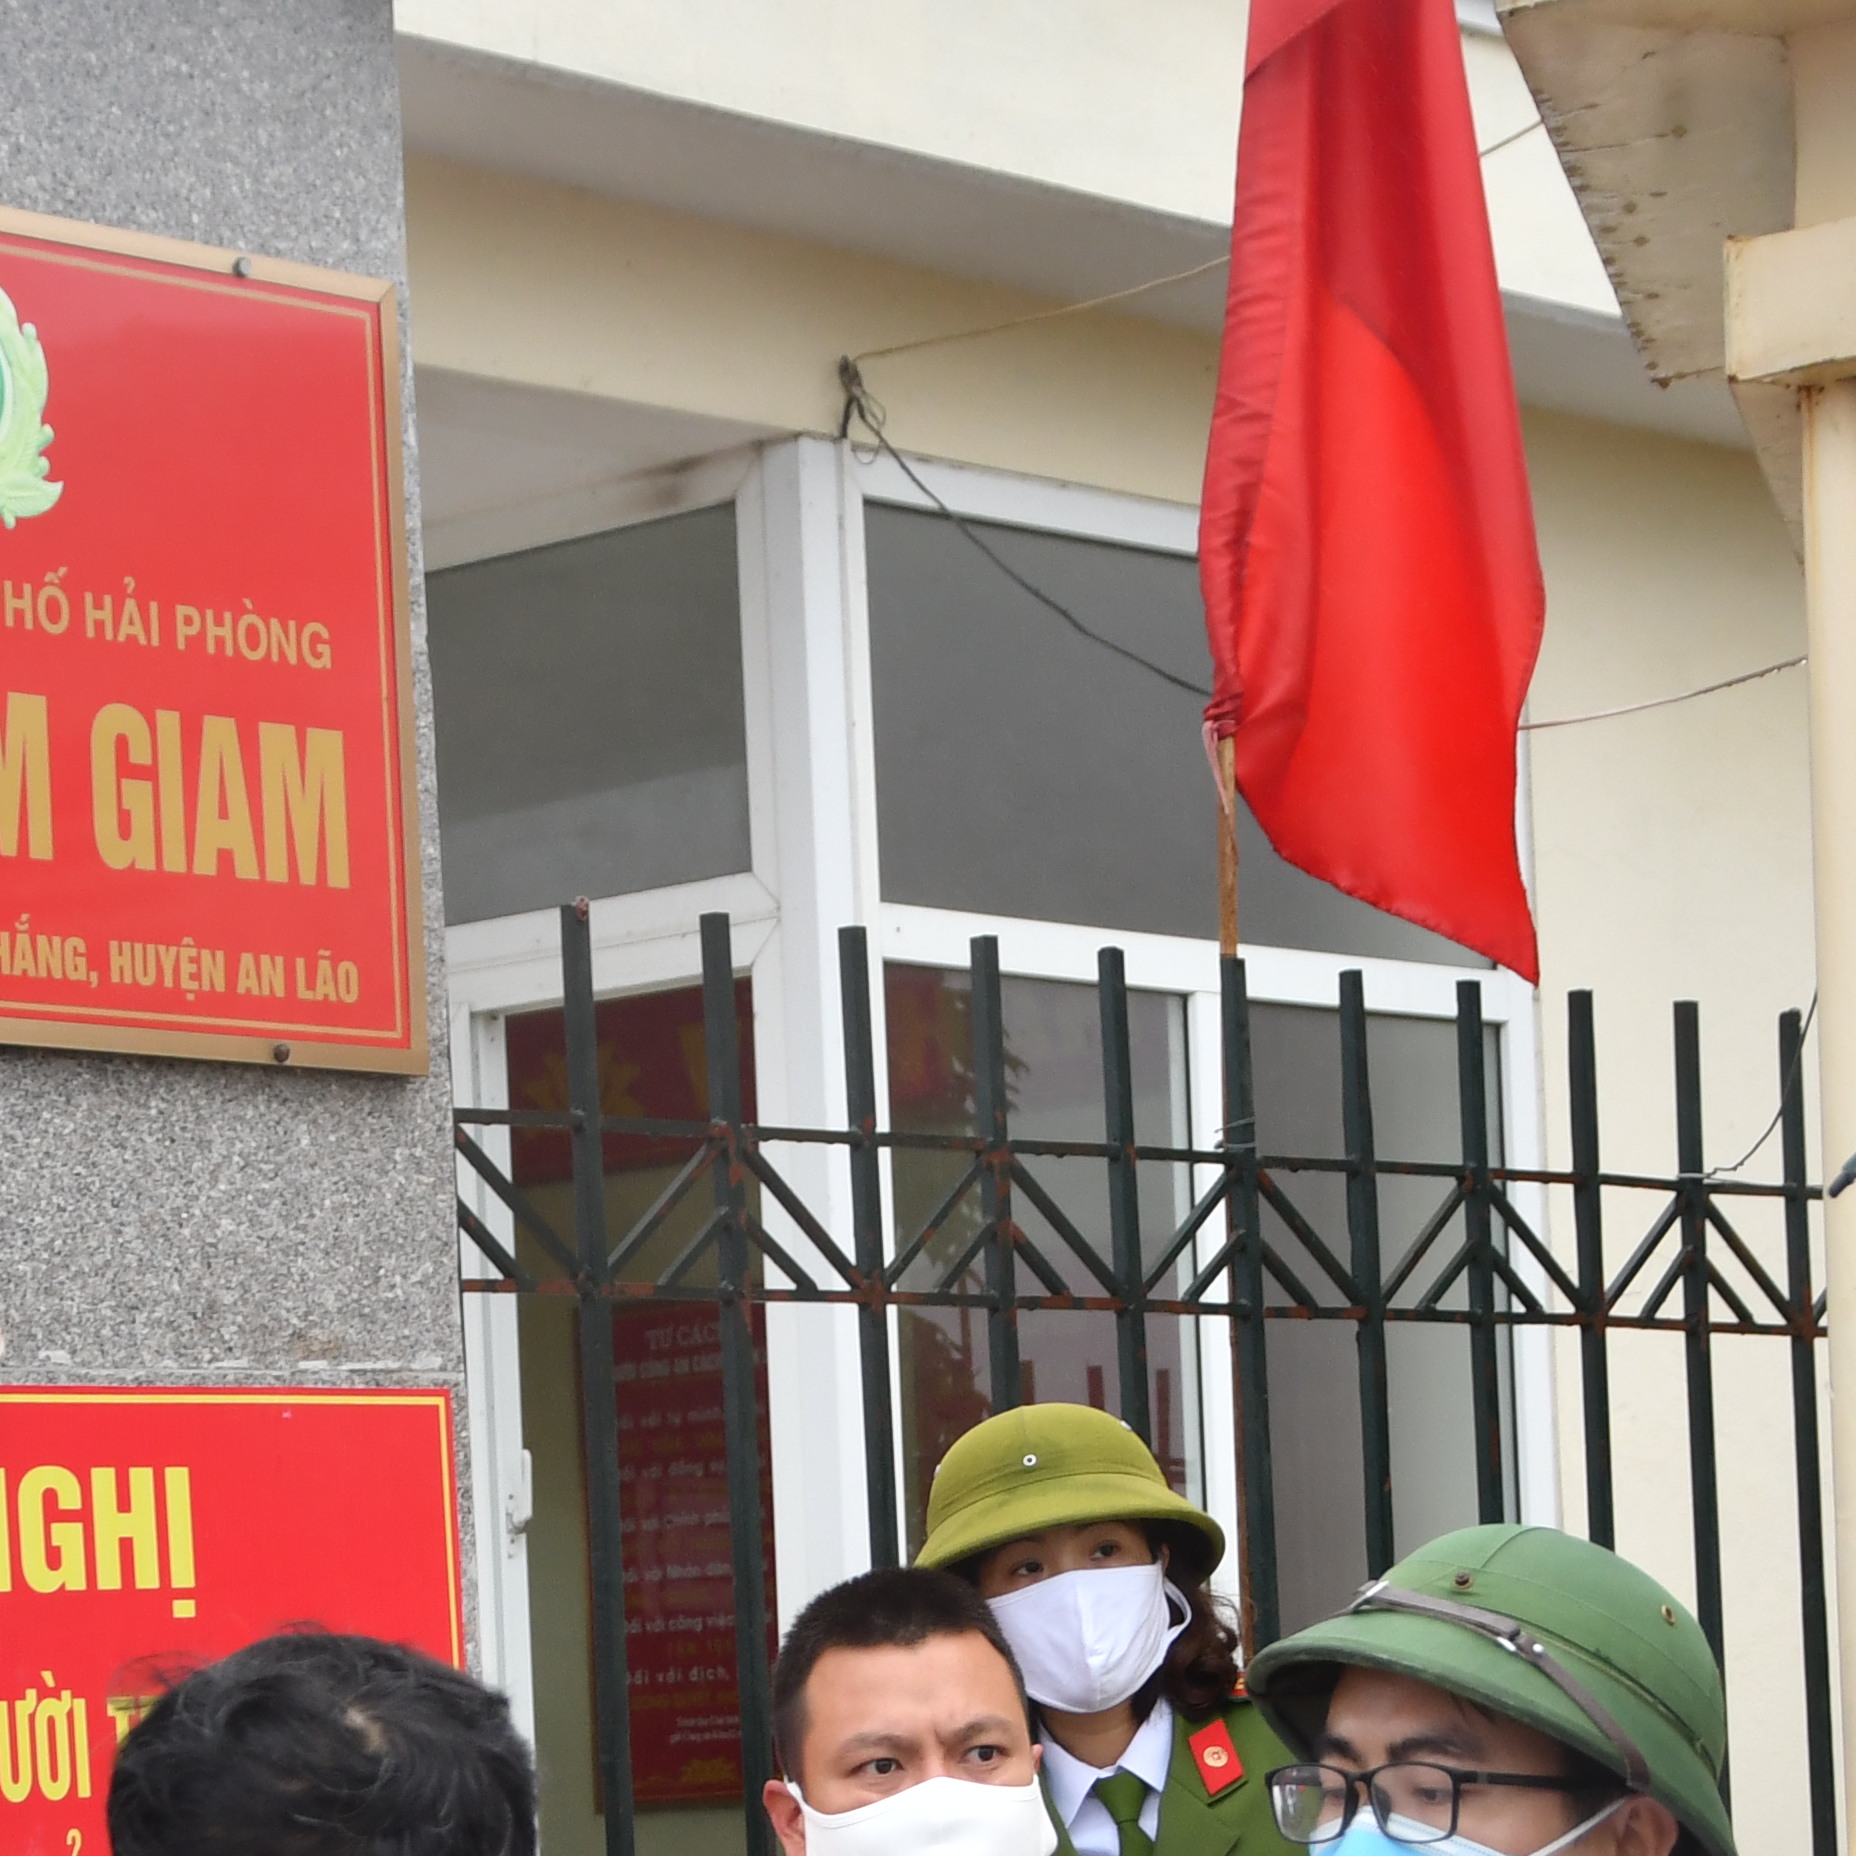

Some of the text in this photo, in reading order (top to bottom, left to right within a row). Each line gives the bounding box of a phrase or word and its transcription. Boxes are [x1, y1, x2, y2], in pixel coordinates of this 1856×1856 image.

[84, 575, 161, 648] HẢI
[175, 597, 333, 671] PHÒNG
[89, 700, 352, 890] GIAM
[107, 935, 227, 1000] HUYỆN
[235, 951, 288, 999] AN
[294, 946, 361, 1006] LÃO
[676, 1317, 722, 1347] CÁC
